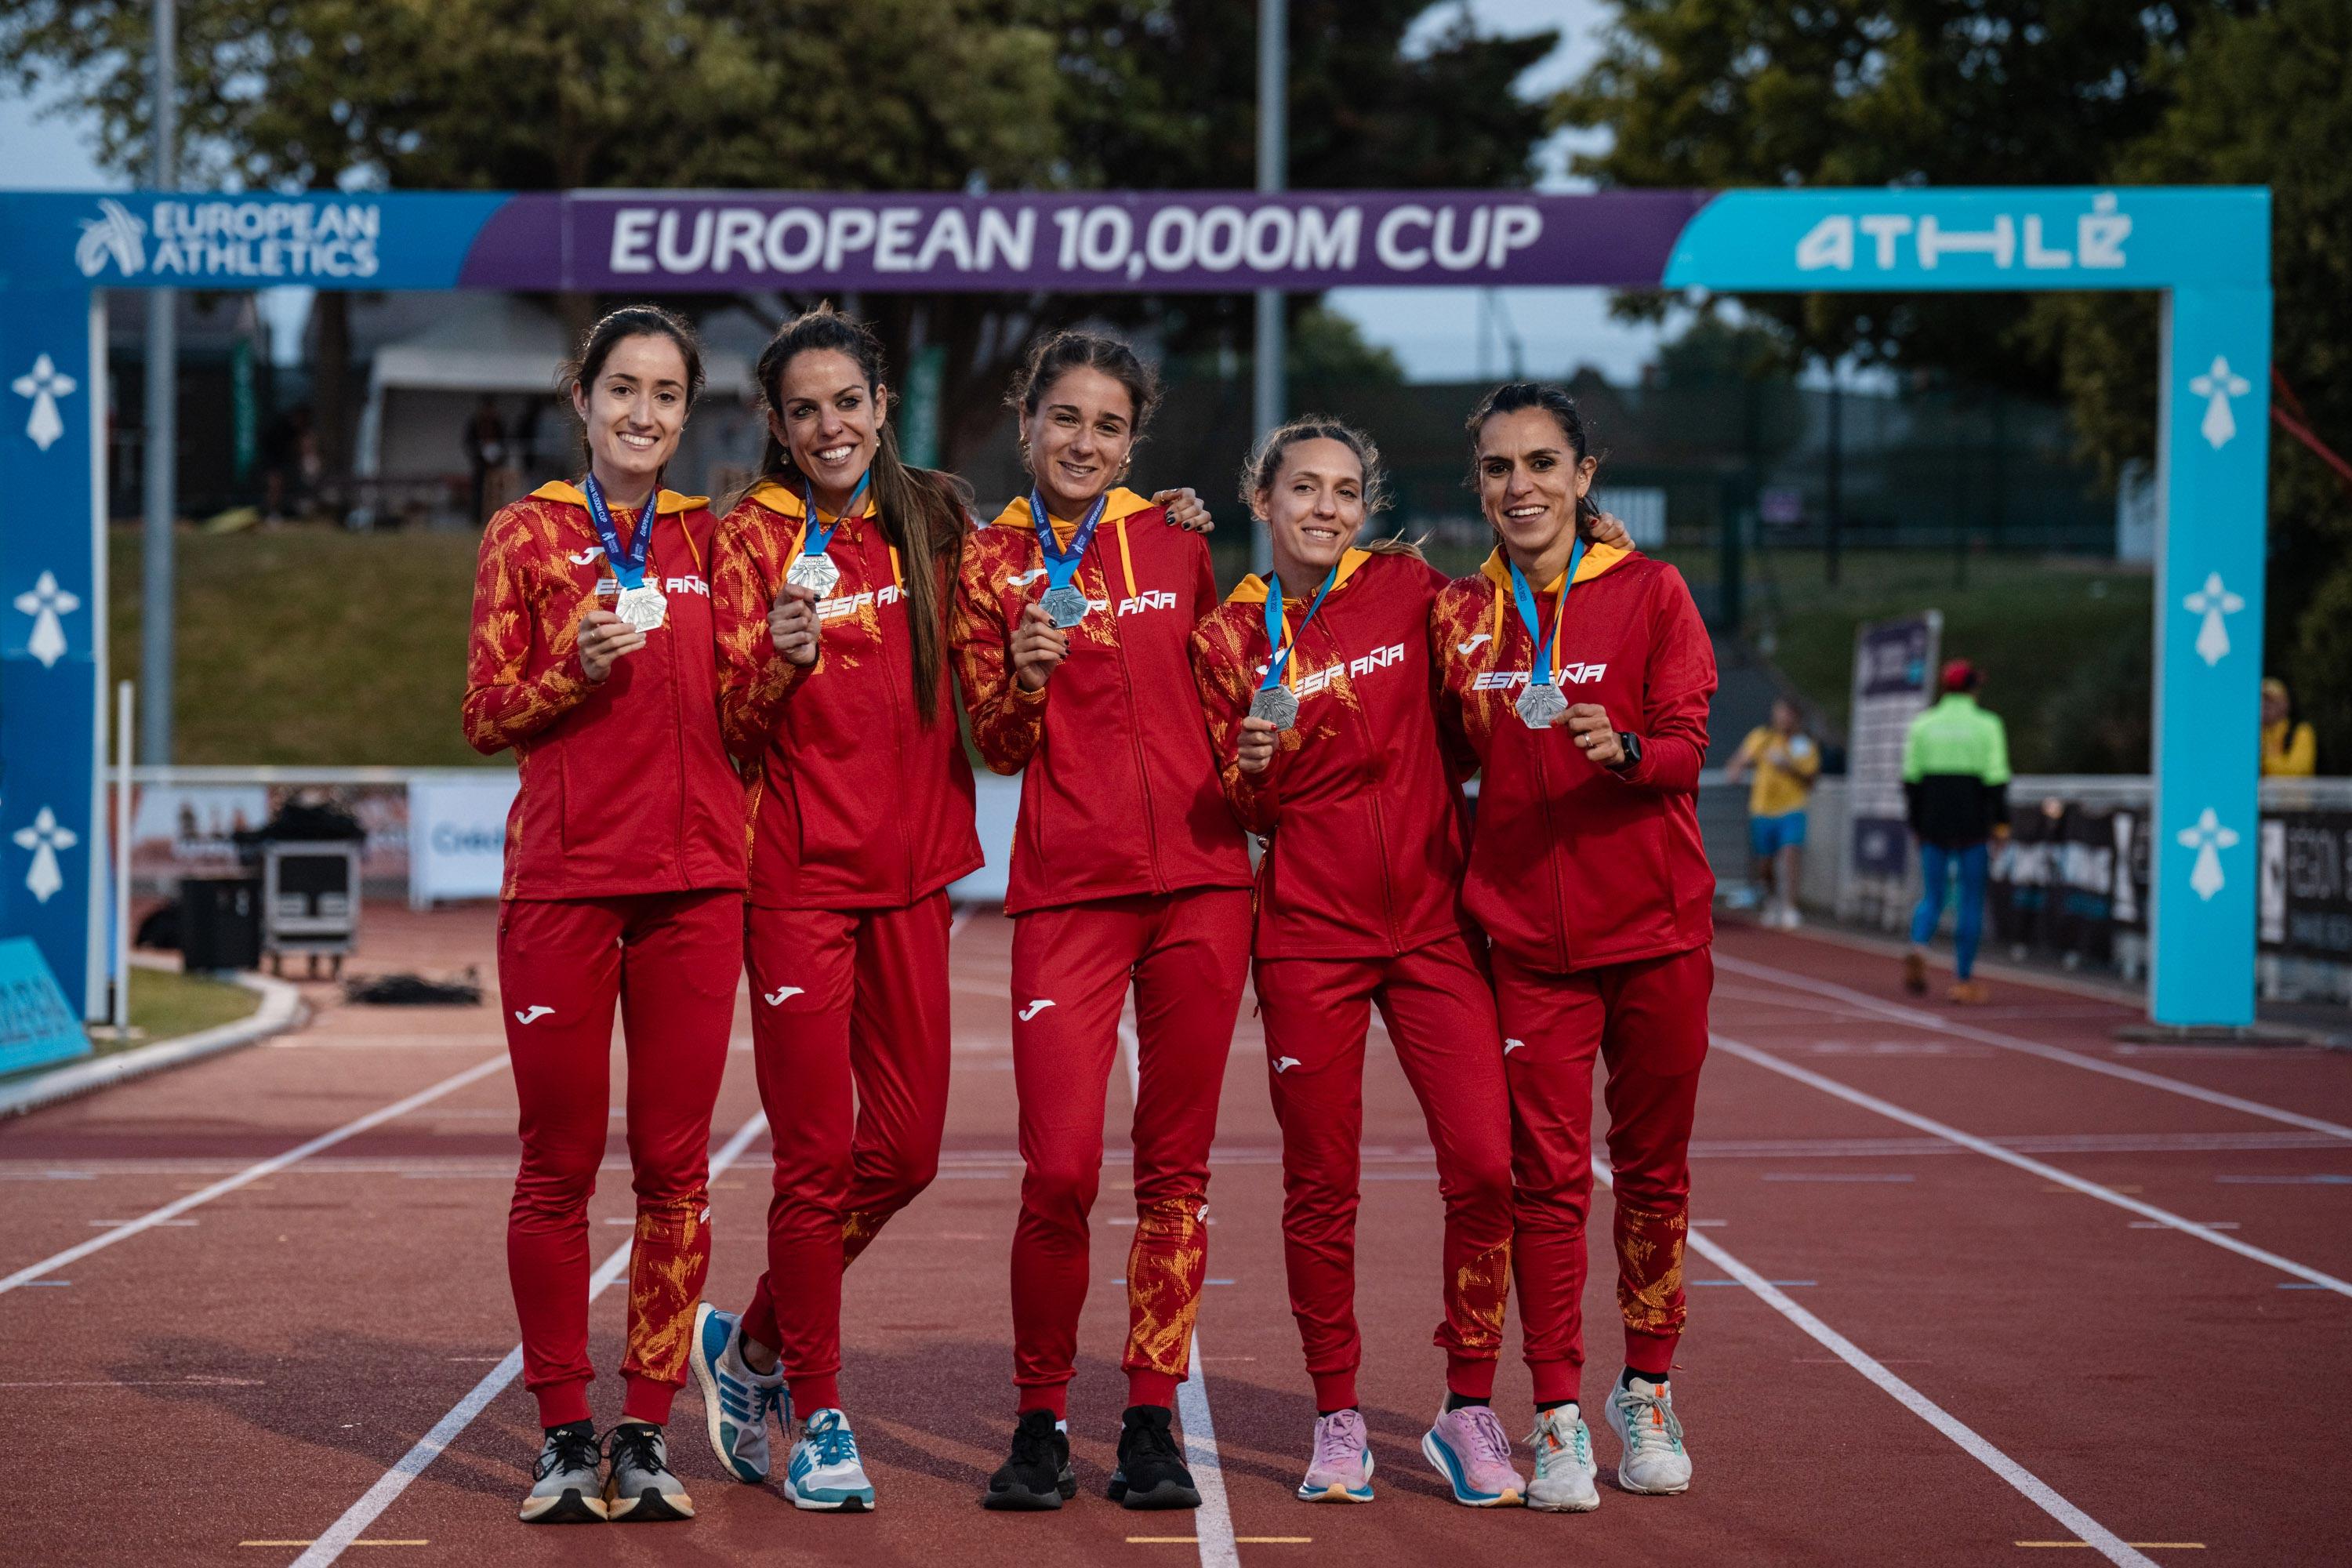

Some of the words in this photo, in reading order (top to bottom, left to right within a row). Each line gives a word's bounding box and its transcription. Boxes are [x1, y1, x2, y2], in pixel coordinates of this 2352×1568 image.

[153, 201, 380, 238] EUROPEAN
[1795, 192, 2132, 271] ATHLÉ
[151, 239, 379, 277] ATHLETICS
[610, 206, 1036, 274] EUROPEAN
[1053, 205, 1363, 281] 10,000M
[1376, 205, 1543, 271] CUP
[598, 511, 608, 523] CUP
[815, 578, 909, 620] ESPA
[1083, 590, 1177, 617] PAÑA
